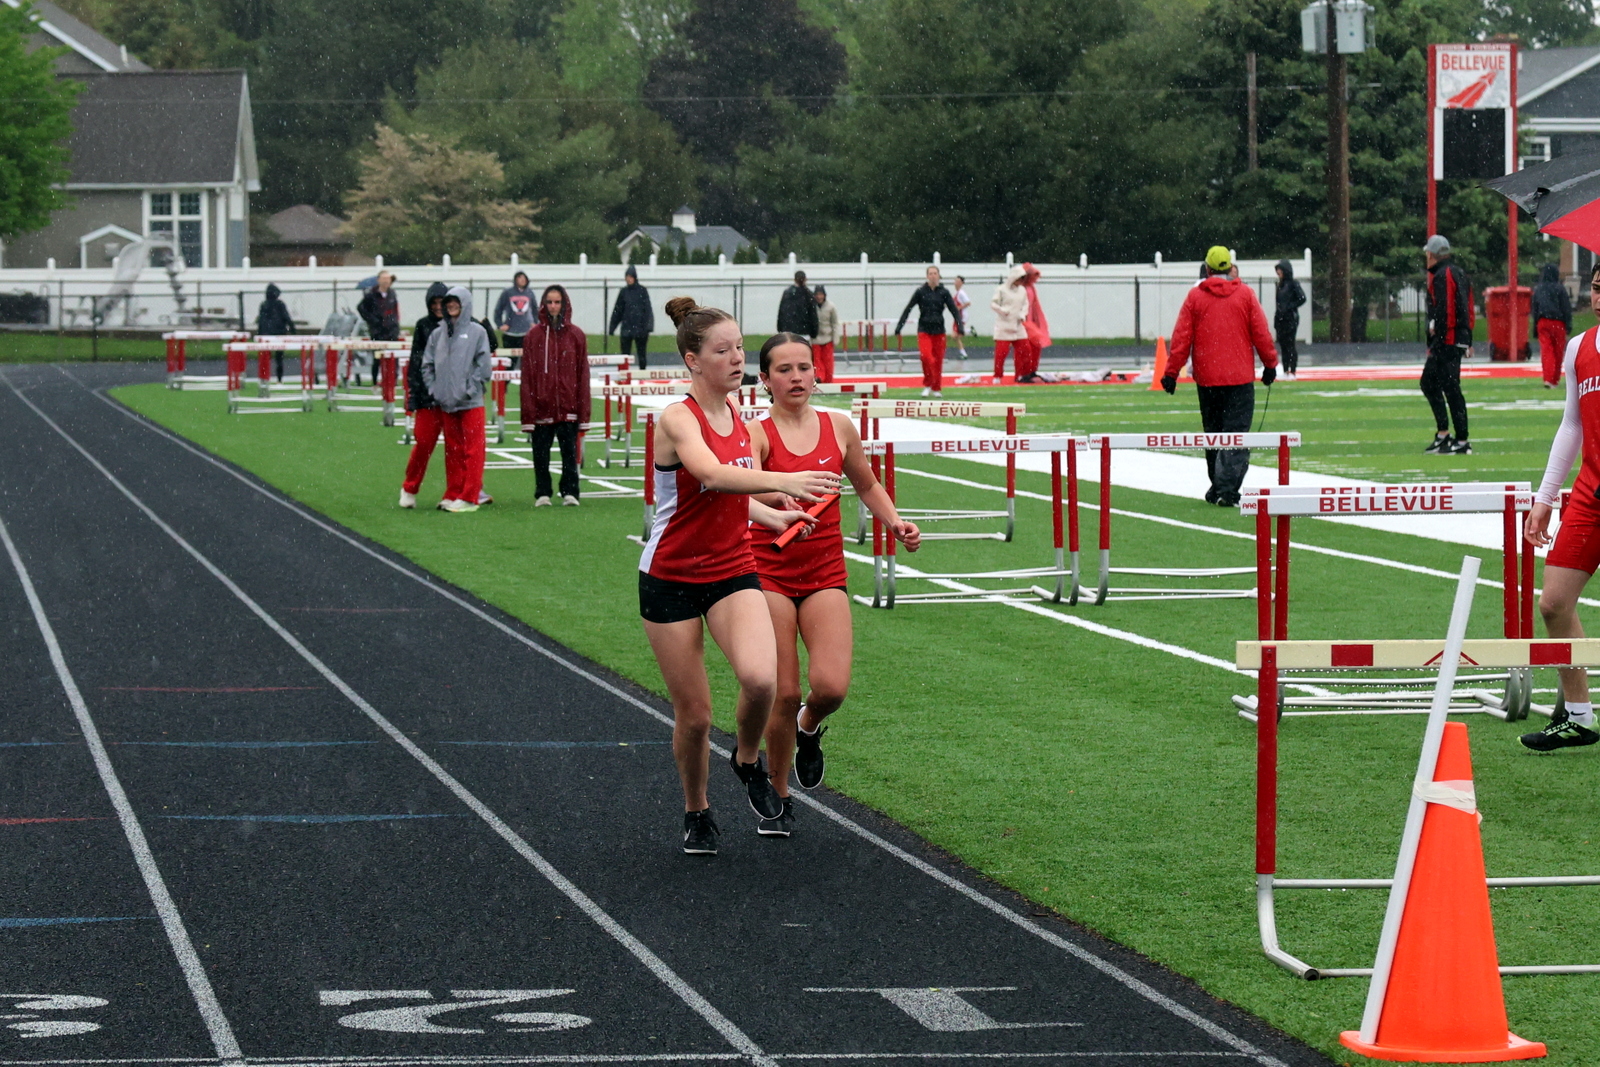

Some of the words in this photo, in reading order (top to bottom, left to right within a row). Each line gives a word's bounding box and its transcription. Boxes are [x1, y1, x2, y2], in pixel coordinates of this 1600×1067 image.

[1442, 53, 1505, 70] BELLEVUE
[650, 371, 689, 379] BELLE
[603, 387, 675, 395] BELLEVUE
[1578, 375, 1600, 399] BELL
[895, 407, 981, 417] BELLEVUE
[931, 439, 1030, 452] BELLEVUE
[1147, 435, 1244, 447] BELLEVUE
[1319, 495, 1453, 512] BELLEVUE
[319, 989, 593, 1034] 2
